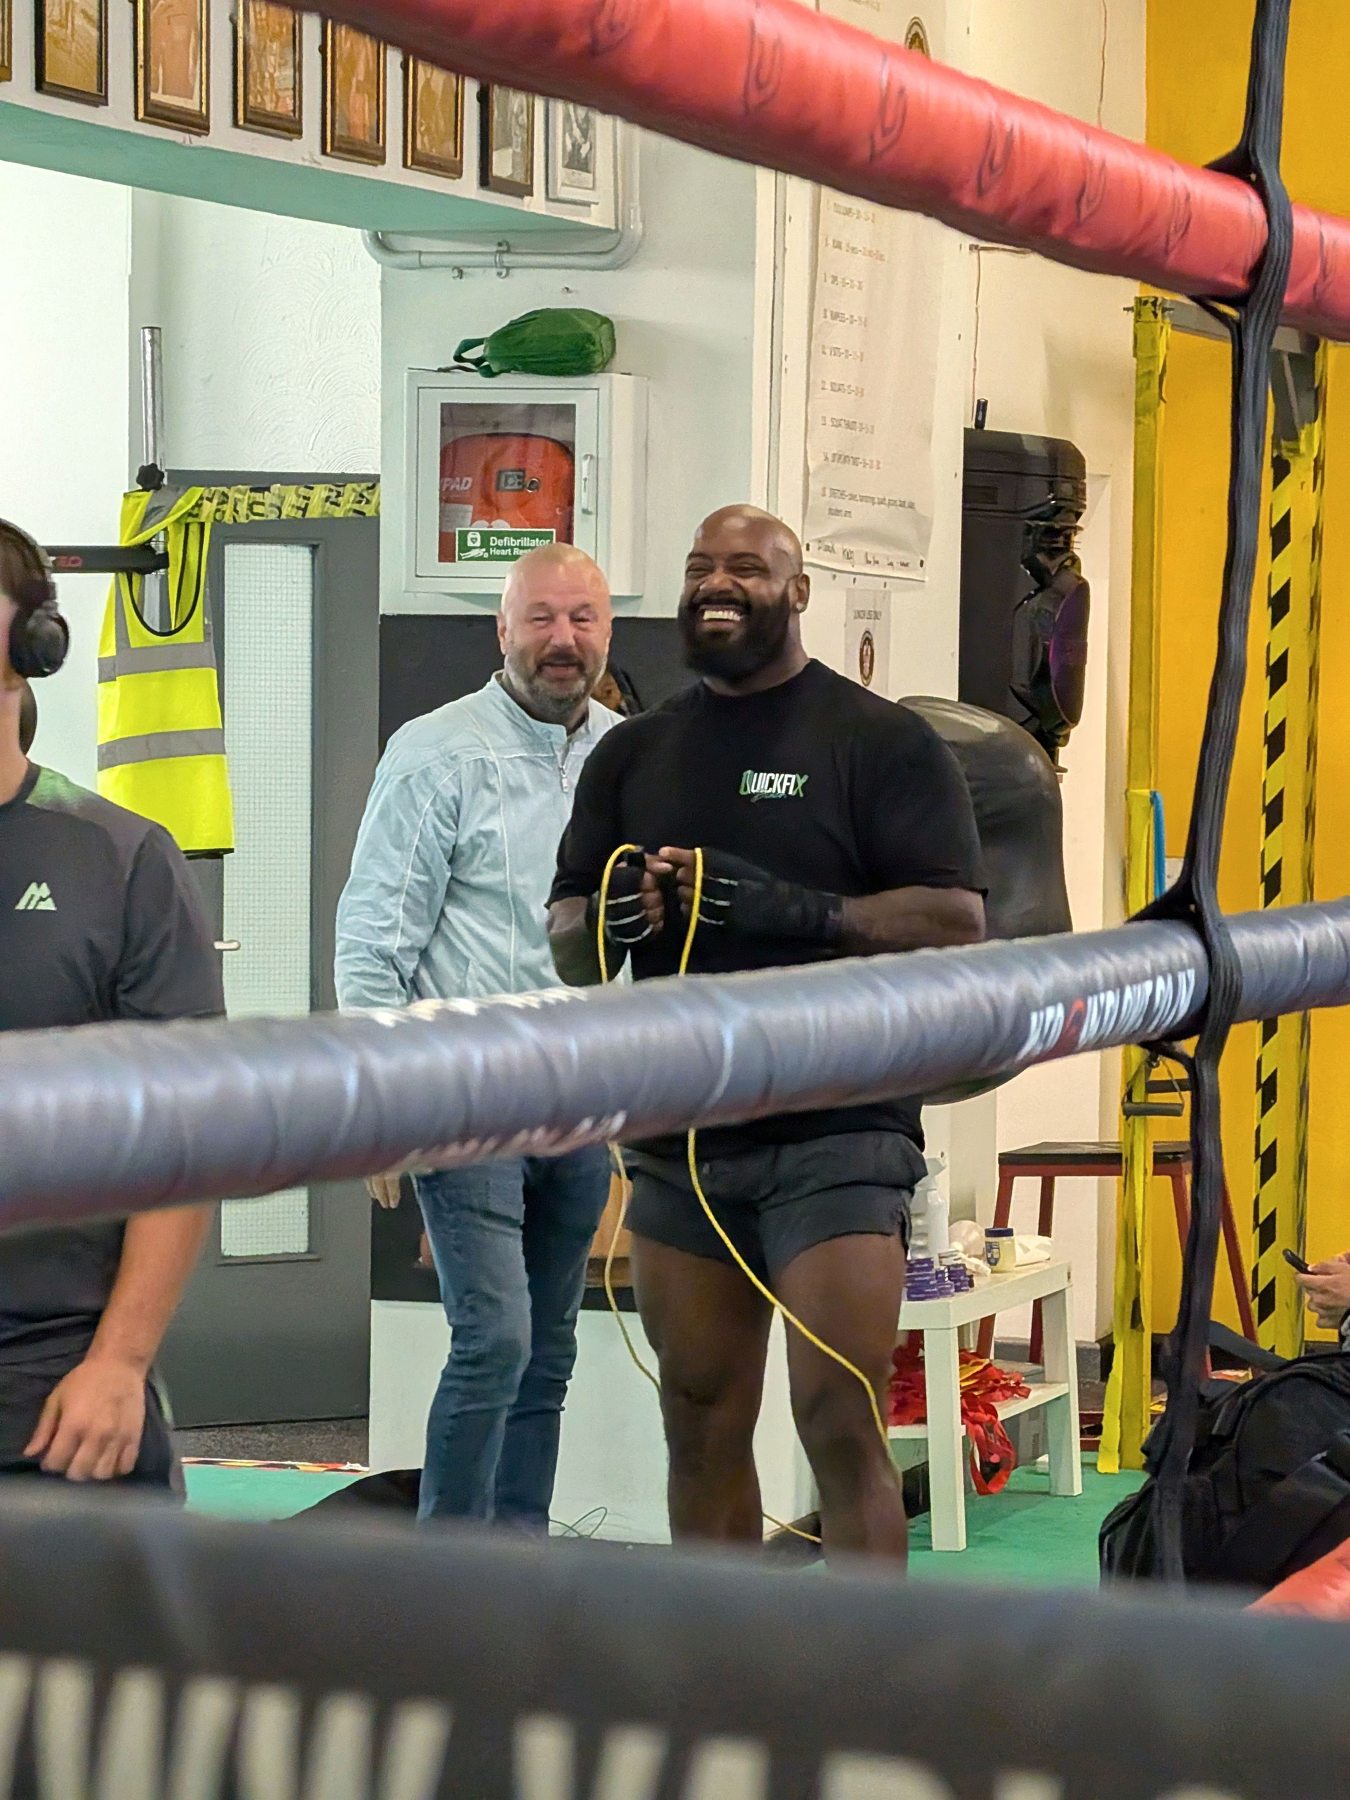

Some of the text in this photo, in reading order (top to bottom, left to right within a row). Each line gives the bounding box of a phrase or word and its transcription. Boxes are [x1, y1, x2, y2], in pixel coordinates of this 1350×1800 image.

[441, 477, 473, 491] PAD
[489, 536, 551, 547] Defibrillator
[489, 547, 511, 556] Heart
[739, 769, 809, 798] QUICKFIX
